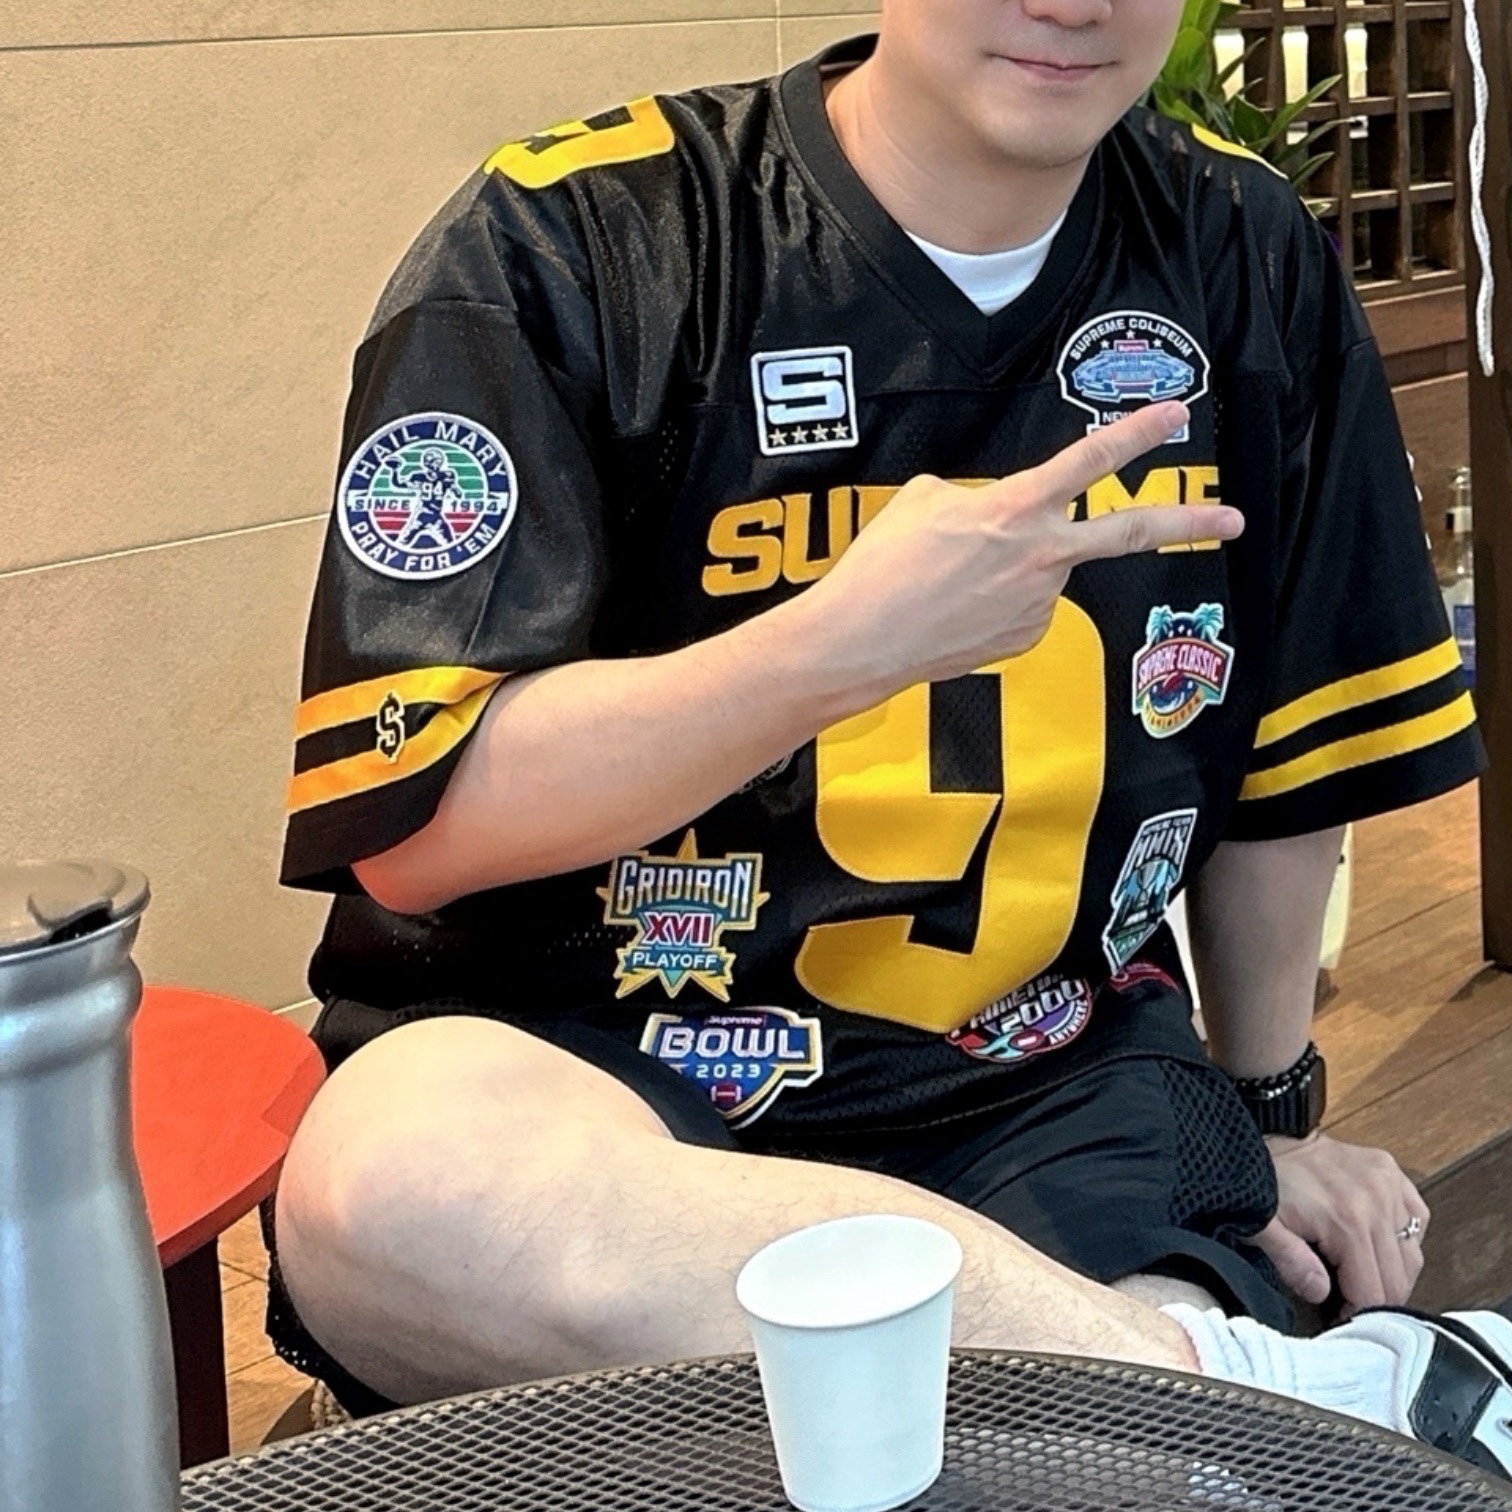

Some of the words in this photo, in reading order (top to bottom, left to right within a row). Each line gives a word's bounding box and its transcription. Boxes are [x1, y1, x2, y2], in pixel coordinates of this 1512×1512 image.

[1070, 318, 1126, 361] SUPREME
[1128, 317, 1193, 358] COLISEUM
[762, 356, 846, 425] S
[354, 425, 421, 480] HAIL
[434, 419, 507, 479] MARY
[355, 498, 412, 511] SINCE
[450, 499, 501, 513] 1994
[421, 482, 444, 502] 94
[351, 520, 399, 566] PRAY
[404, 552, 451, 571] FOR
[456, 522, 497, 553] 'EM
[1177, 643, 1223, 683] CLASSIC
[795, 595, 1105, 1033] 9
[617, 859, 752, 920] GRIDIRON
[642, 912, 714, 948] XVII
[632, 952, 719, 970] PLAYOFF
[658, 1027, 805, 1061] BOWL
[696, 1063, 761, 1079] 2023
